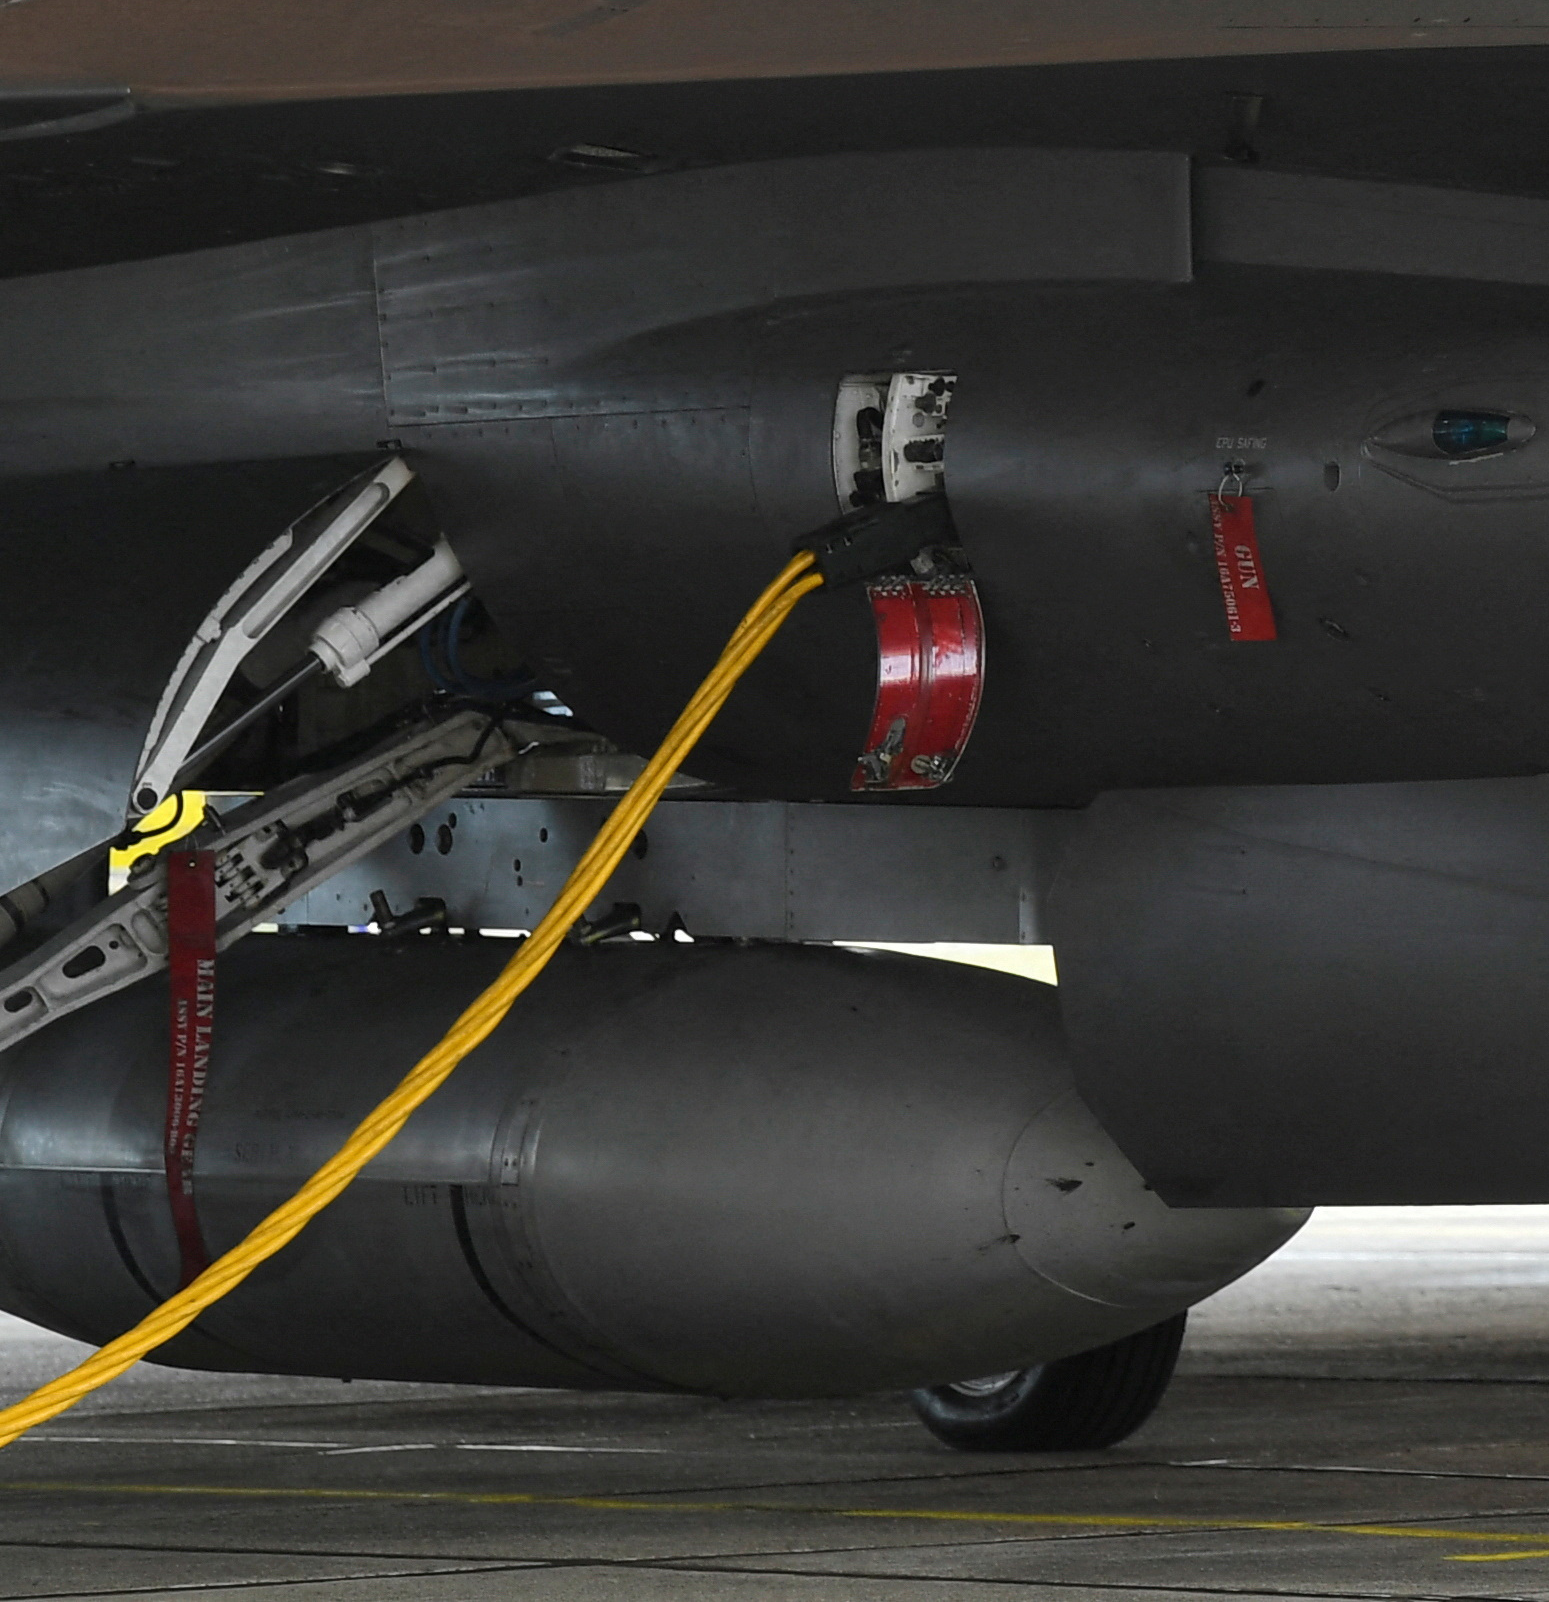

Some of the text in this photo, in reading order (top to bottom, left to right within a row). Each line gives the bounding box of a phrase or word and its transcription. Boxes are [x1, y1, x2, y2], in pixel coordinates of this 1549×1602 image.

[1234, 544, 1260, 591] GUN
[196, 959, 216, 1019] MAIN
[186, 1025, 212, 1127] LANDING
